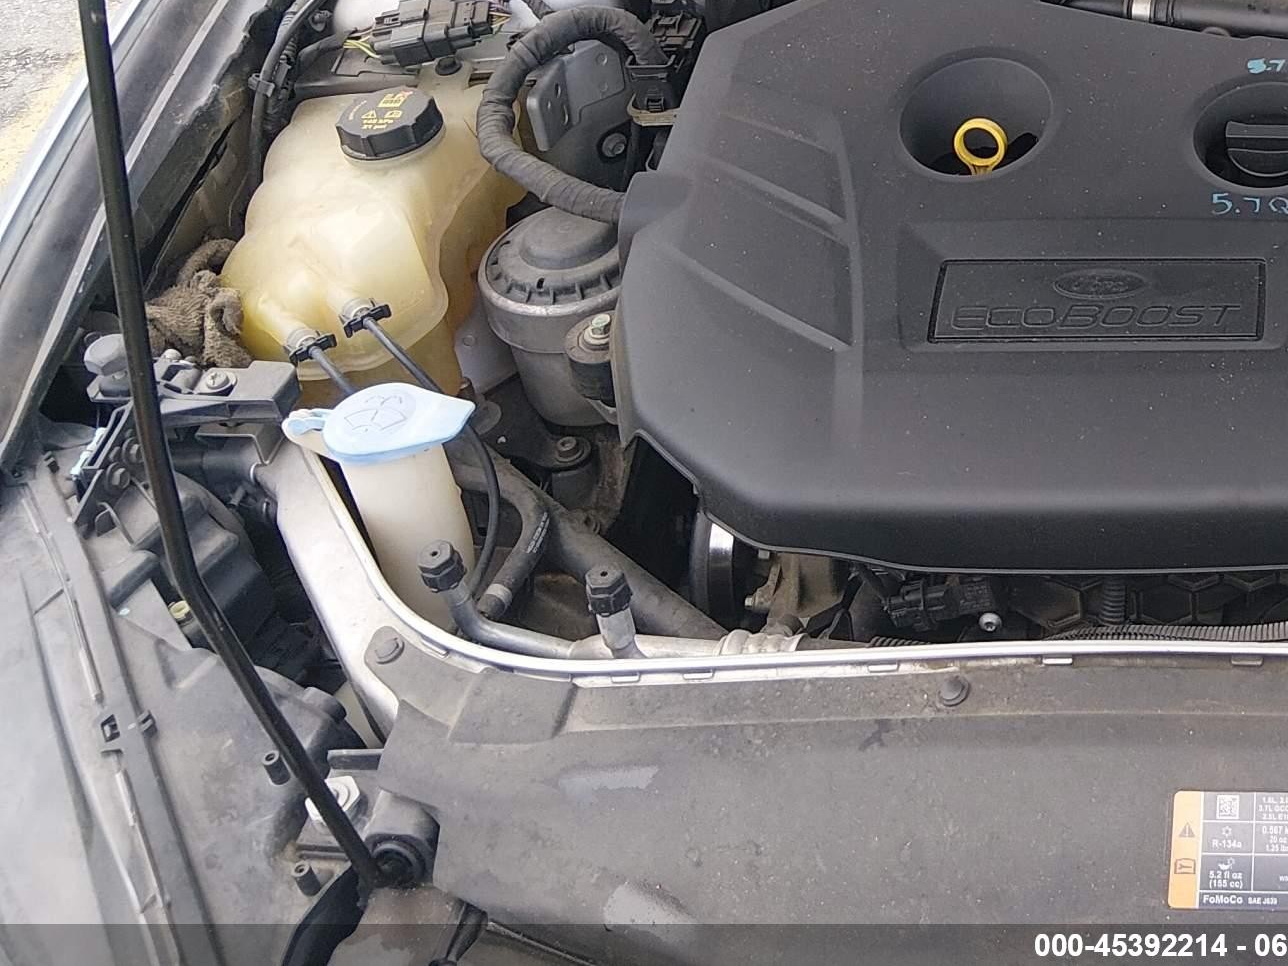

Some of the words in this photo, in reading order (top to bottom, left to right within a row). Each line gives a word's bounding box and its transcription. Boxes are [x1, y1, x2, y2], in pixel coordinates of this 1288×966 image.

[1211, 192, 1261, 215] 5.7
[1211, 839, 1242, 849] R-134a
[1208, 870, 1222, 879] 5.2
[1223, 870, 1230, 879] fl
[1231, 872, 1243, 880] oz
[1209, 879, 1228, 889] (155
[1229, 880, 1243, 890] cc)
[1202, 894, 1244, 905] FoMoCo
[1247, 896, 1262, 905] SAE
